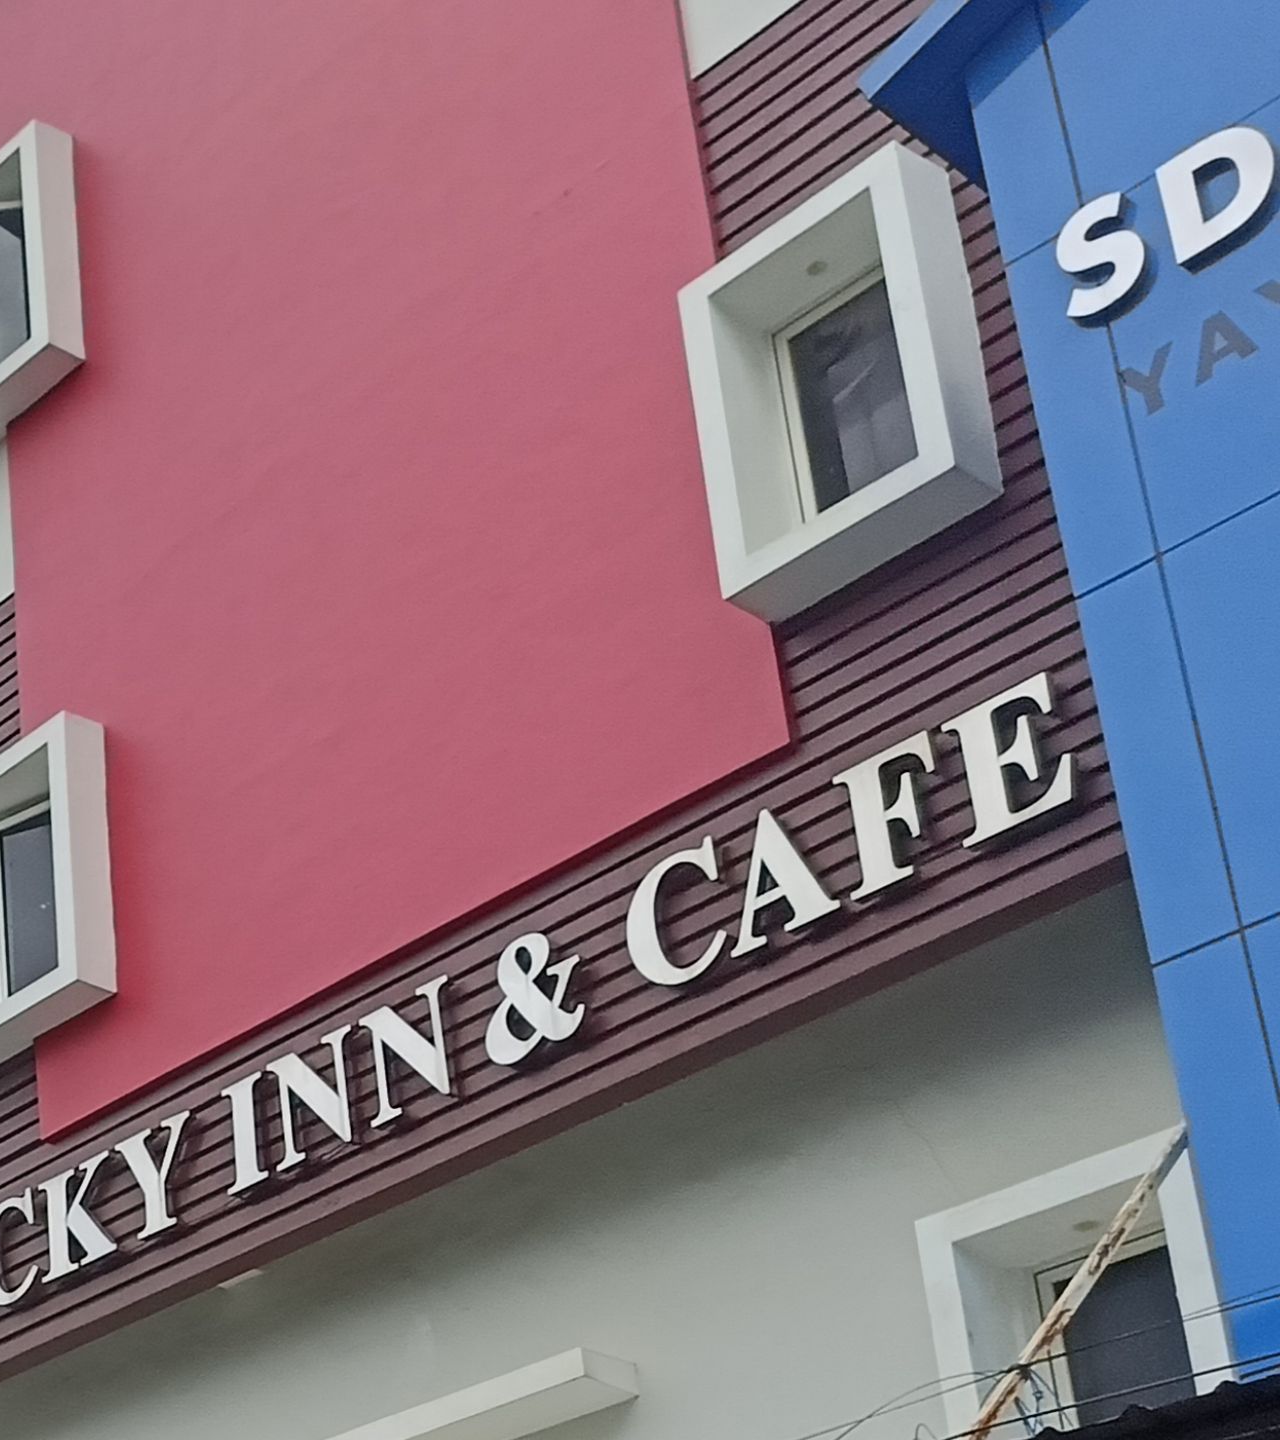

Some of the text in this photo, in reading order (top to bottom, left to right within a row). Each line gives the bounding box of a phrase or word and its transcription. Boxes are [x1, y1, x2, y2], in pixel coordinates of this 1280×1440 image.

[1056, 125, 1276, 318] SD
[220, 974, 451, 1196] INN
[485, 932, 585, 1065] &
[625, 671, 1074, 986] CAFE
